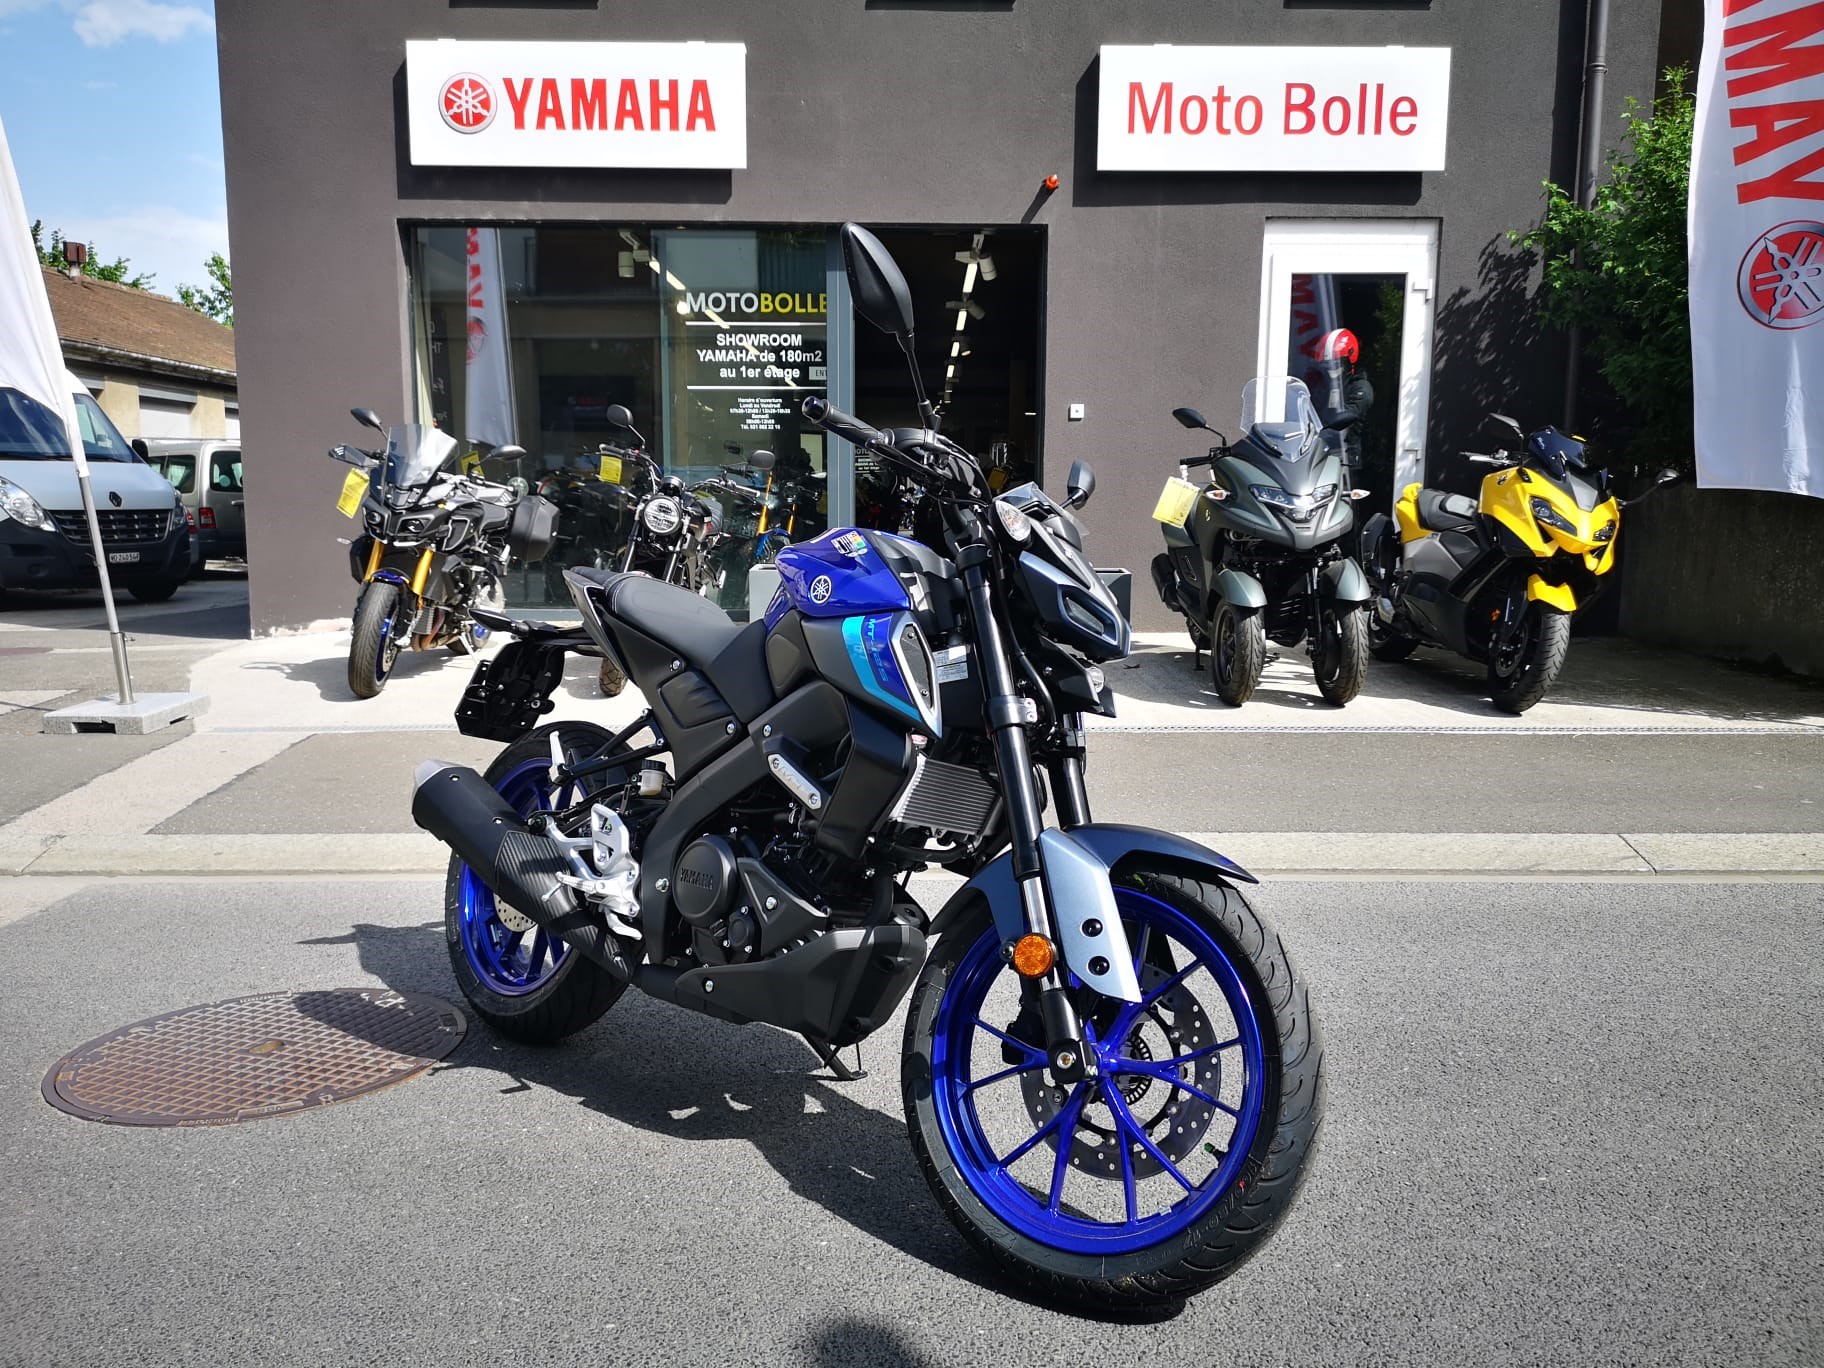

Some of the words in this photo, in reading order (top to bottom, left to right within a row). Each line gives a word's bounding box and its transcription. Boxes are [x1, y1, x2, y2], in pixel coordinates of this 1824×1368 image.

[502, 77, 716, 131] YAMAHA
[1128, 82, 1263, 135] Moto
[1283, 82, 1418, 136] Bolle
[1723, 0, 1824, 205] YAM
[716, 333, 802, 347] SHOWROOM
[696, 349, 757, 362] YAMAHA
[759, 350, 776, 362] de
[719, 367, 736, 378] au
[740, 365, 761, 378] 1er
[763, 364, 801, 380] étage
[680, 867, 714, 890] YAMAHA
